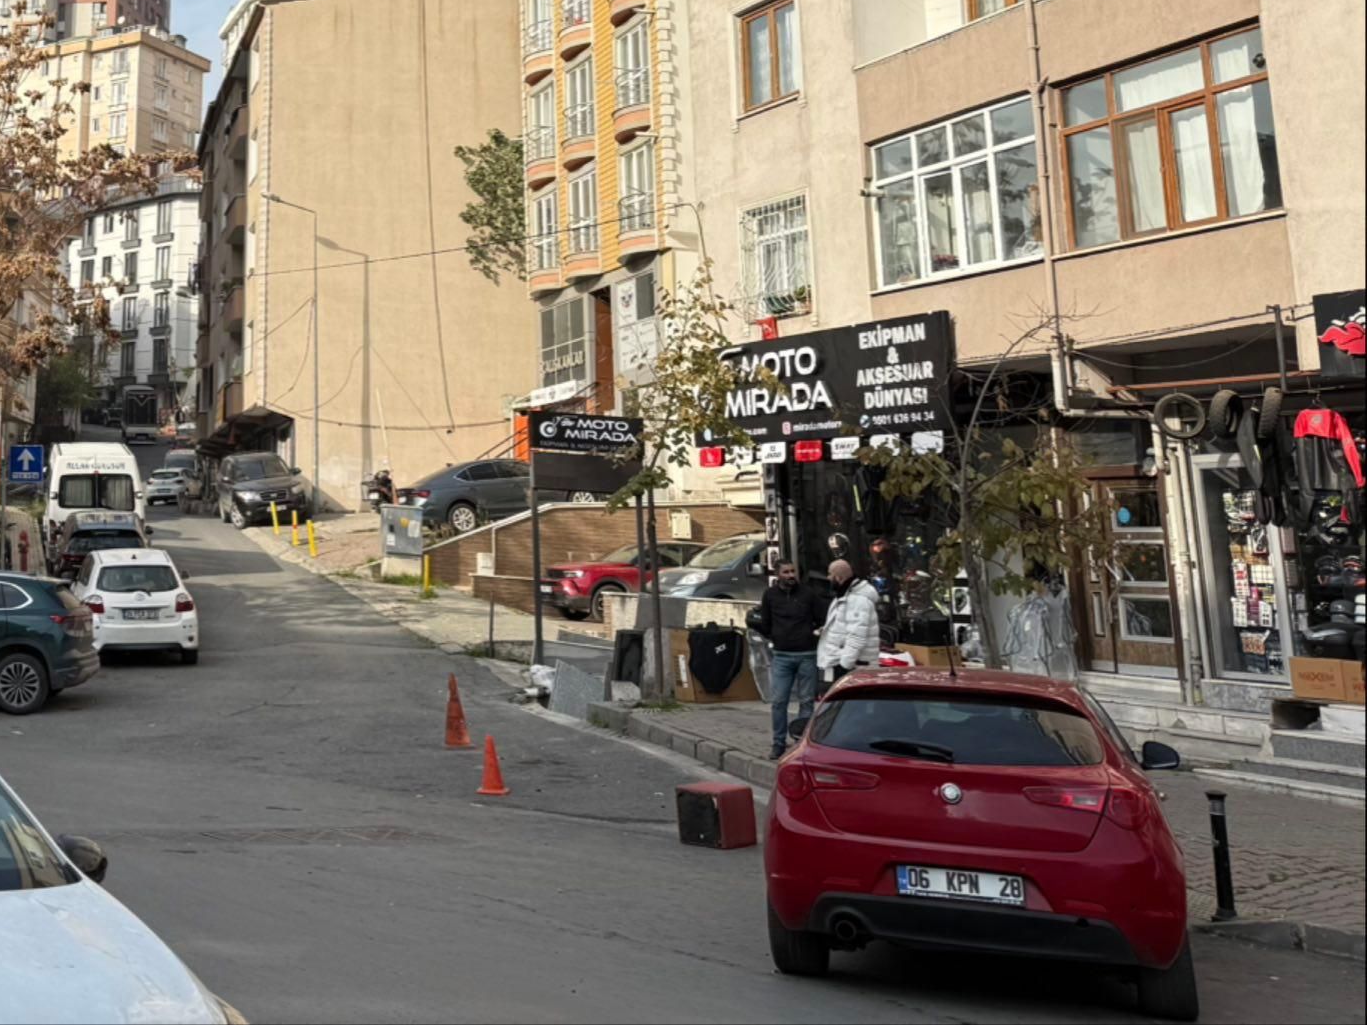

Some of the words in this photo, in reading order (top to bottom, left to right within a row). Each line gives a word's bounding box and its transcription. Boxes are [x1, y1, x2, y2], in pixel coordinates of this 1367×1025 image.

[858, 323, 926, 350] EKİPMAN
[738, 345, 817, 382] MOTO
[886, 346, 900, 365] &
[856, 360, 934, 388] AKSESUAR
[724, 379, 833, 418] MIRADA
[863, 385, 928, 410] DÜNYASI
[565, 429, 637, 444] MIRADA
[577, 419, 629, 431] MOTO
[907, 868, 930, 888] 06
[945, 871, 981, 894] KPN
[998, 877, 1022, 898] 28
